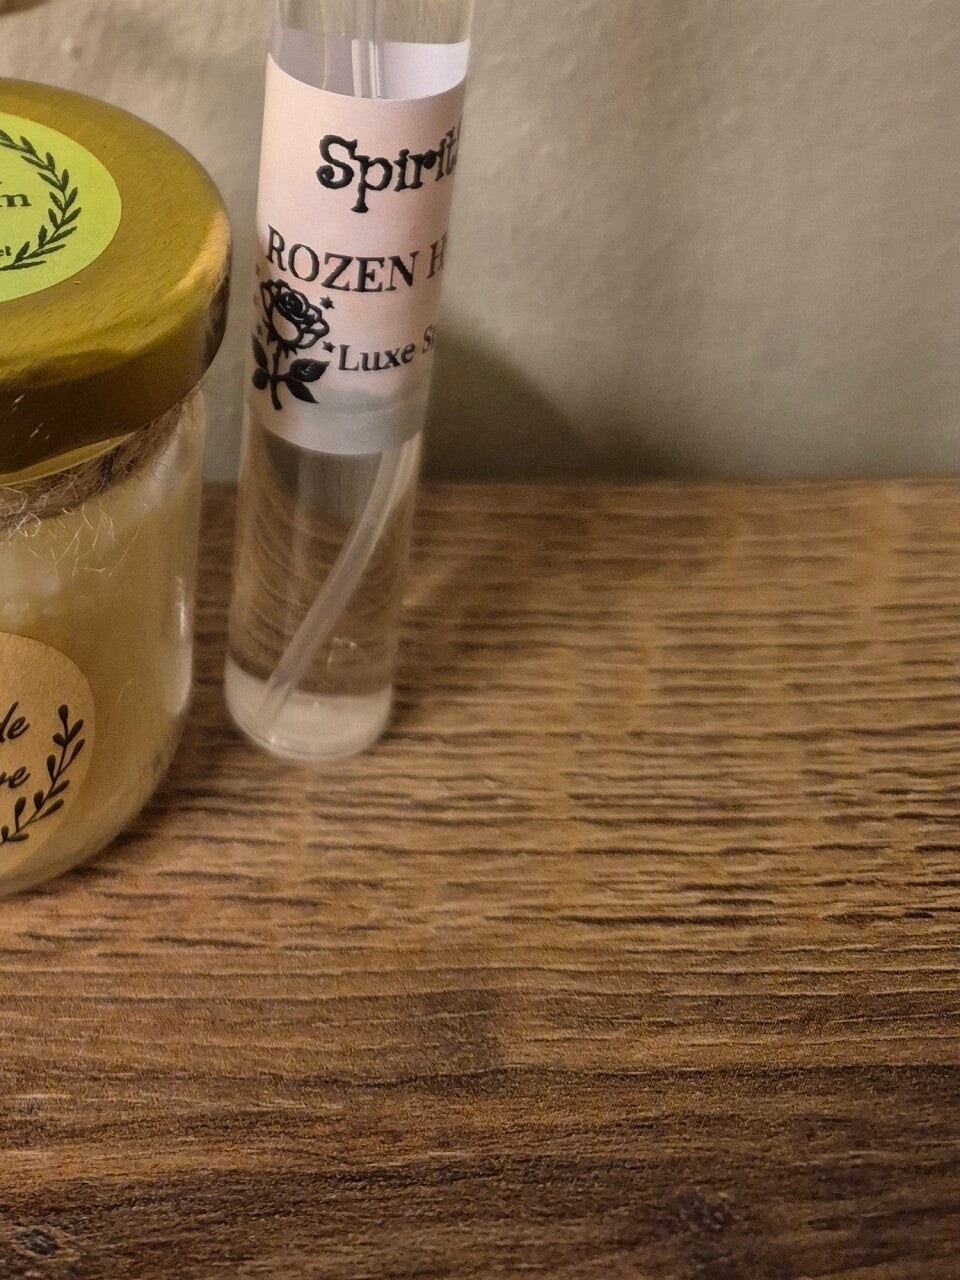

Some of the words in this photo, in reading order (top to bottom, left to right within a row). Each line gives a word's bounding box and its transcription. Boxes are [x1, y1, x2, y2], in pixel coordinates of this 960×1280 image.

[316, 118, 461, 213] Spirit
[266, 224, 419, 292] ROZEN
[337, 342, 415, 371] Luxe
